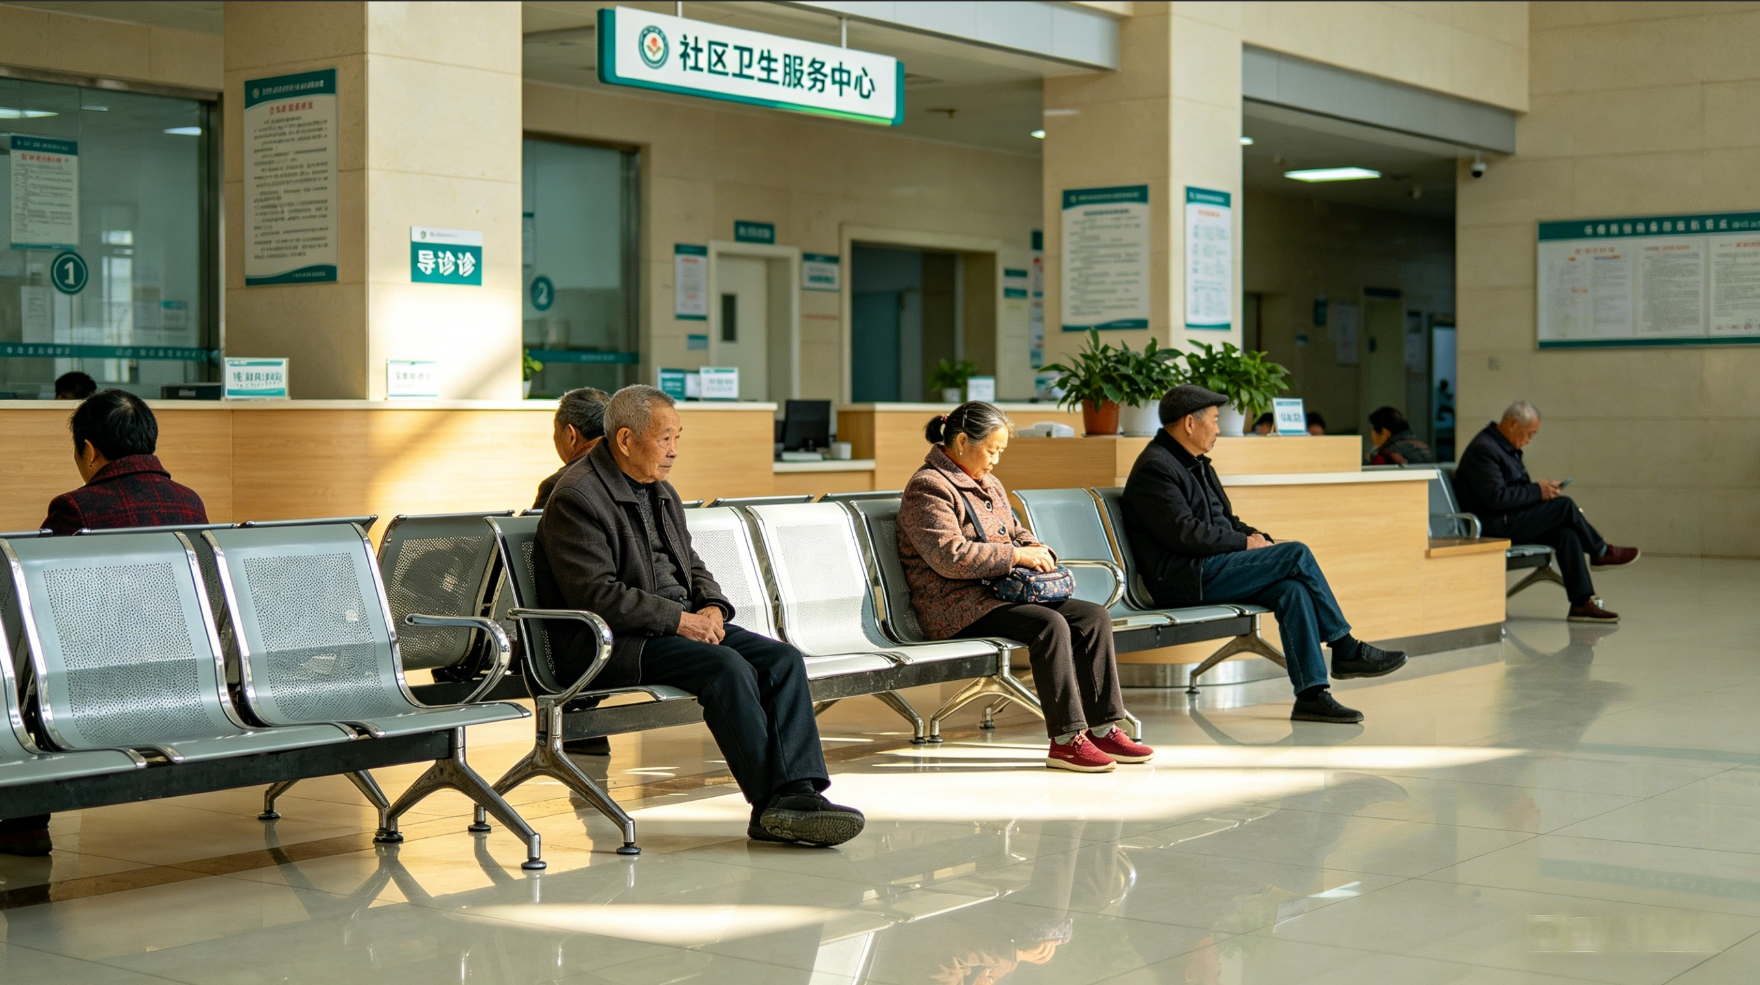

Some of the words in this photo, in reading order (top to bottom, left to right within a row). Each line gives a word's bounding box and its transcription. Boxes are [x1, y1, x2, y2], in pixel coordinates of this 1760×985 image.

[679, 34, 876, 100] 社区卫生服务中心
[64, 261, 75, 285] 1
[537, 282, 549, 305] 2
